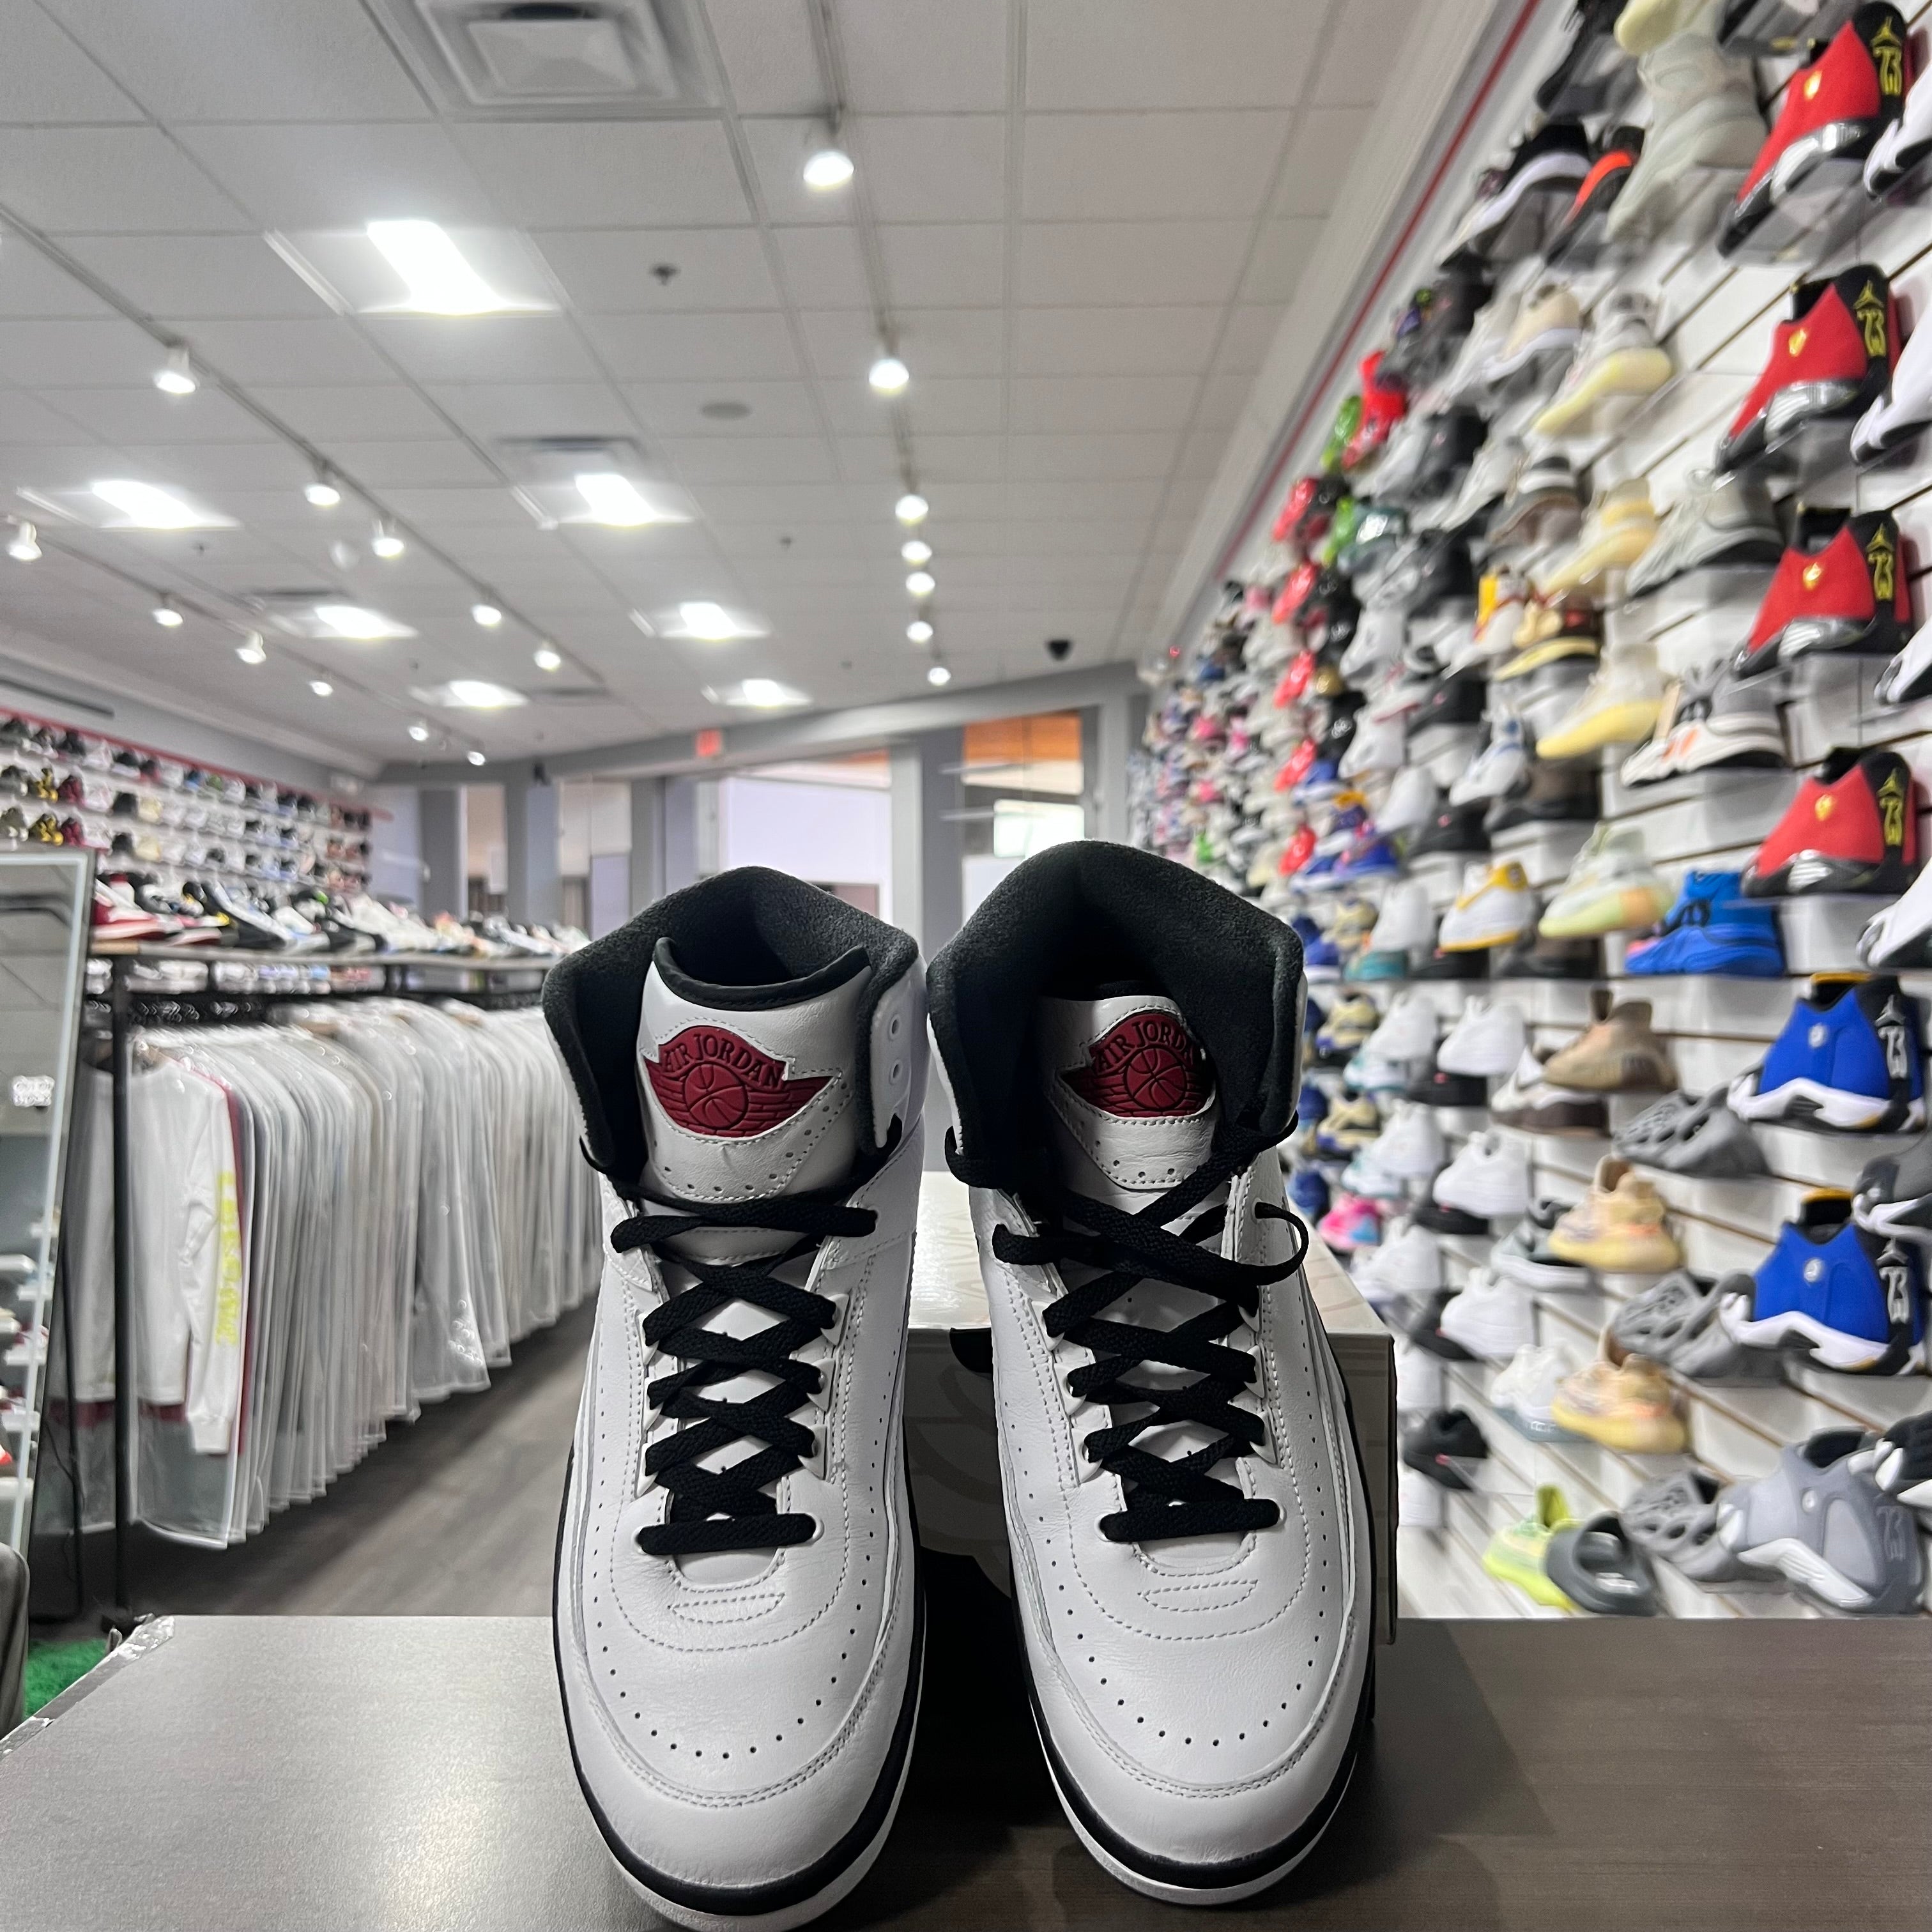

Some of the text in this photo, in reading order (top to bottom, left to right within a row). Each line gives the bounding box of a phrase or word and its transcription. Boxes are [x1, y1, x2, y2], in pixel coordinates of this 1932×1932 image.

[663, 1033, 783, 1087] AIR JORDAN
[1097, 1020, 1196, 1071] AIR JORDA
